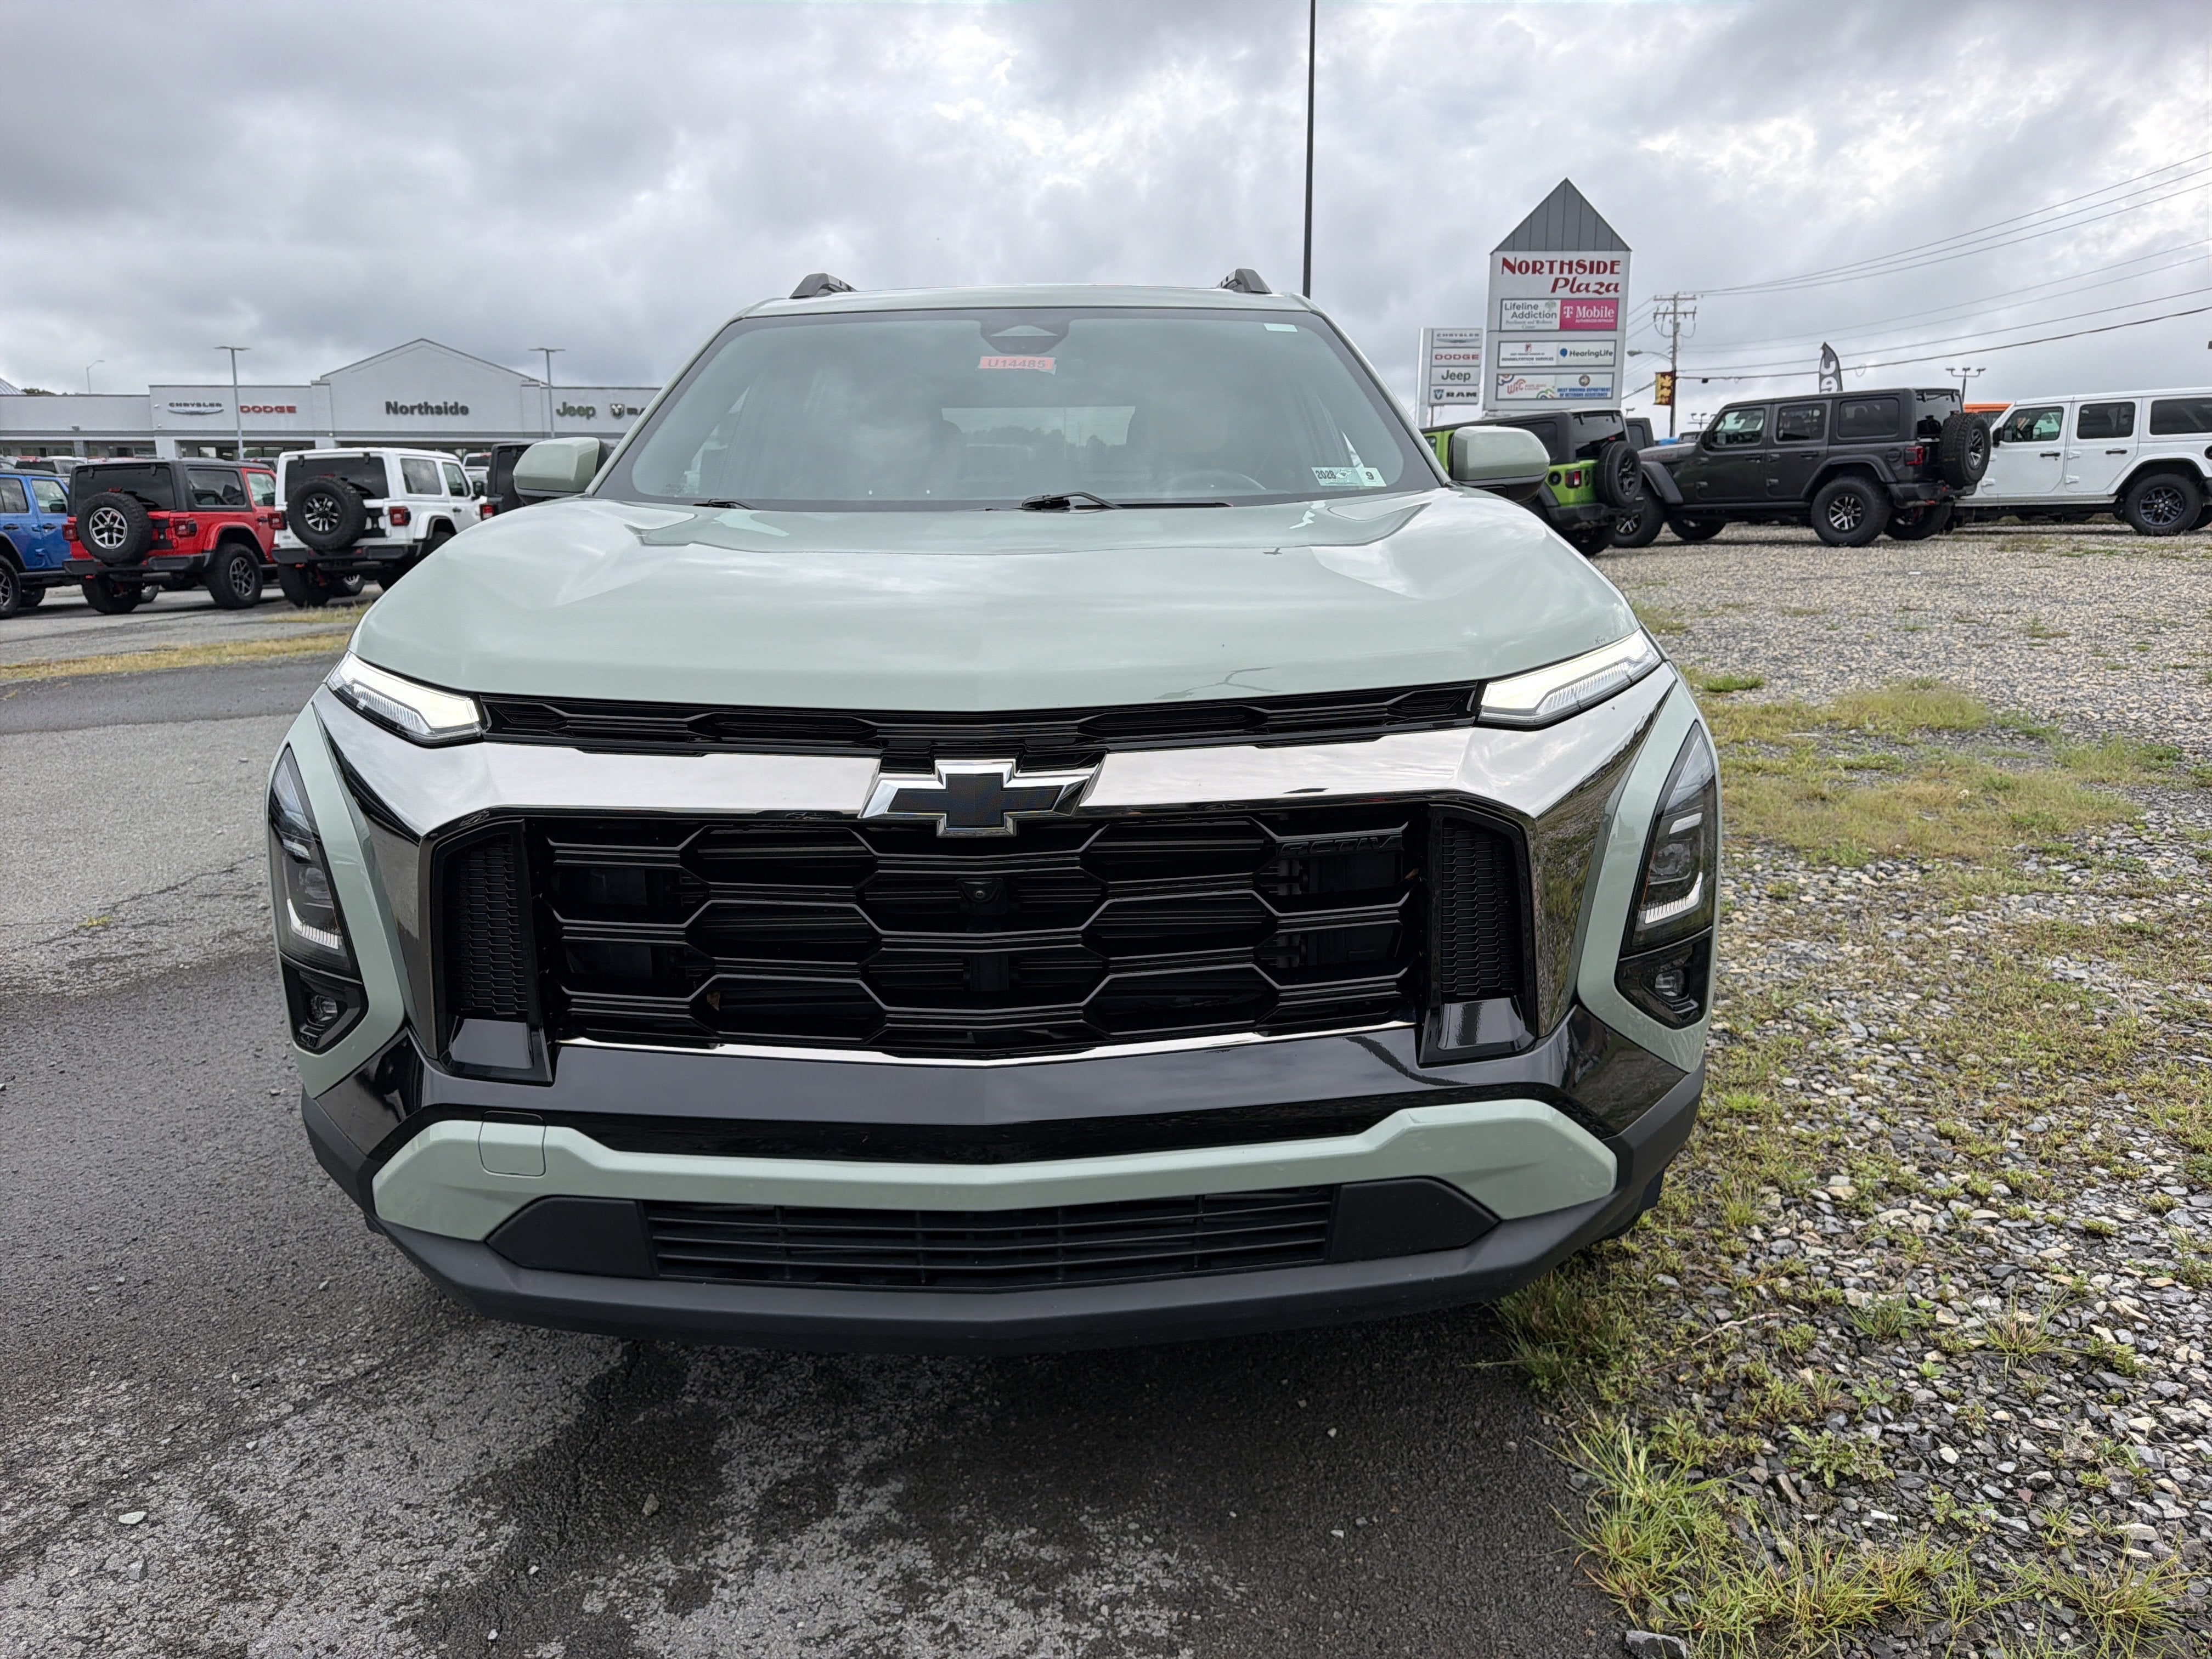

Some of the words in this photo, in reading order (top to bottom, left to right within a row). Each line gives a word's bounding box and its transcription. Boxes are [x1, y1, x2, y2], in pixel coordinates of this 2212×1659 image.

[1501, 257, 1621, 275] NORTHSIDE
[1550, 276, 1620, 295] Plaza
[1504, 302, 1539, 311] Lifeline
[1576, 306, 1615, 318] Mobile
[1511, 311, 1558, 319] Addiction
[1569, 349, 1613, 358] HearingLife
[988, 359, 1046, 368] U14485
[1441, 369, 1471, 382] Jeep
[240, 405, 297, 414] DODGE
[385, 401, 470, 415] Northside
[556, 401, 597, 420] Jeep
